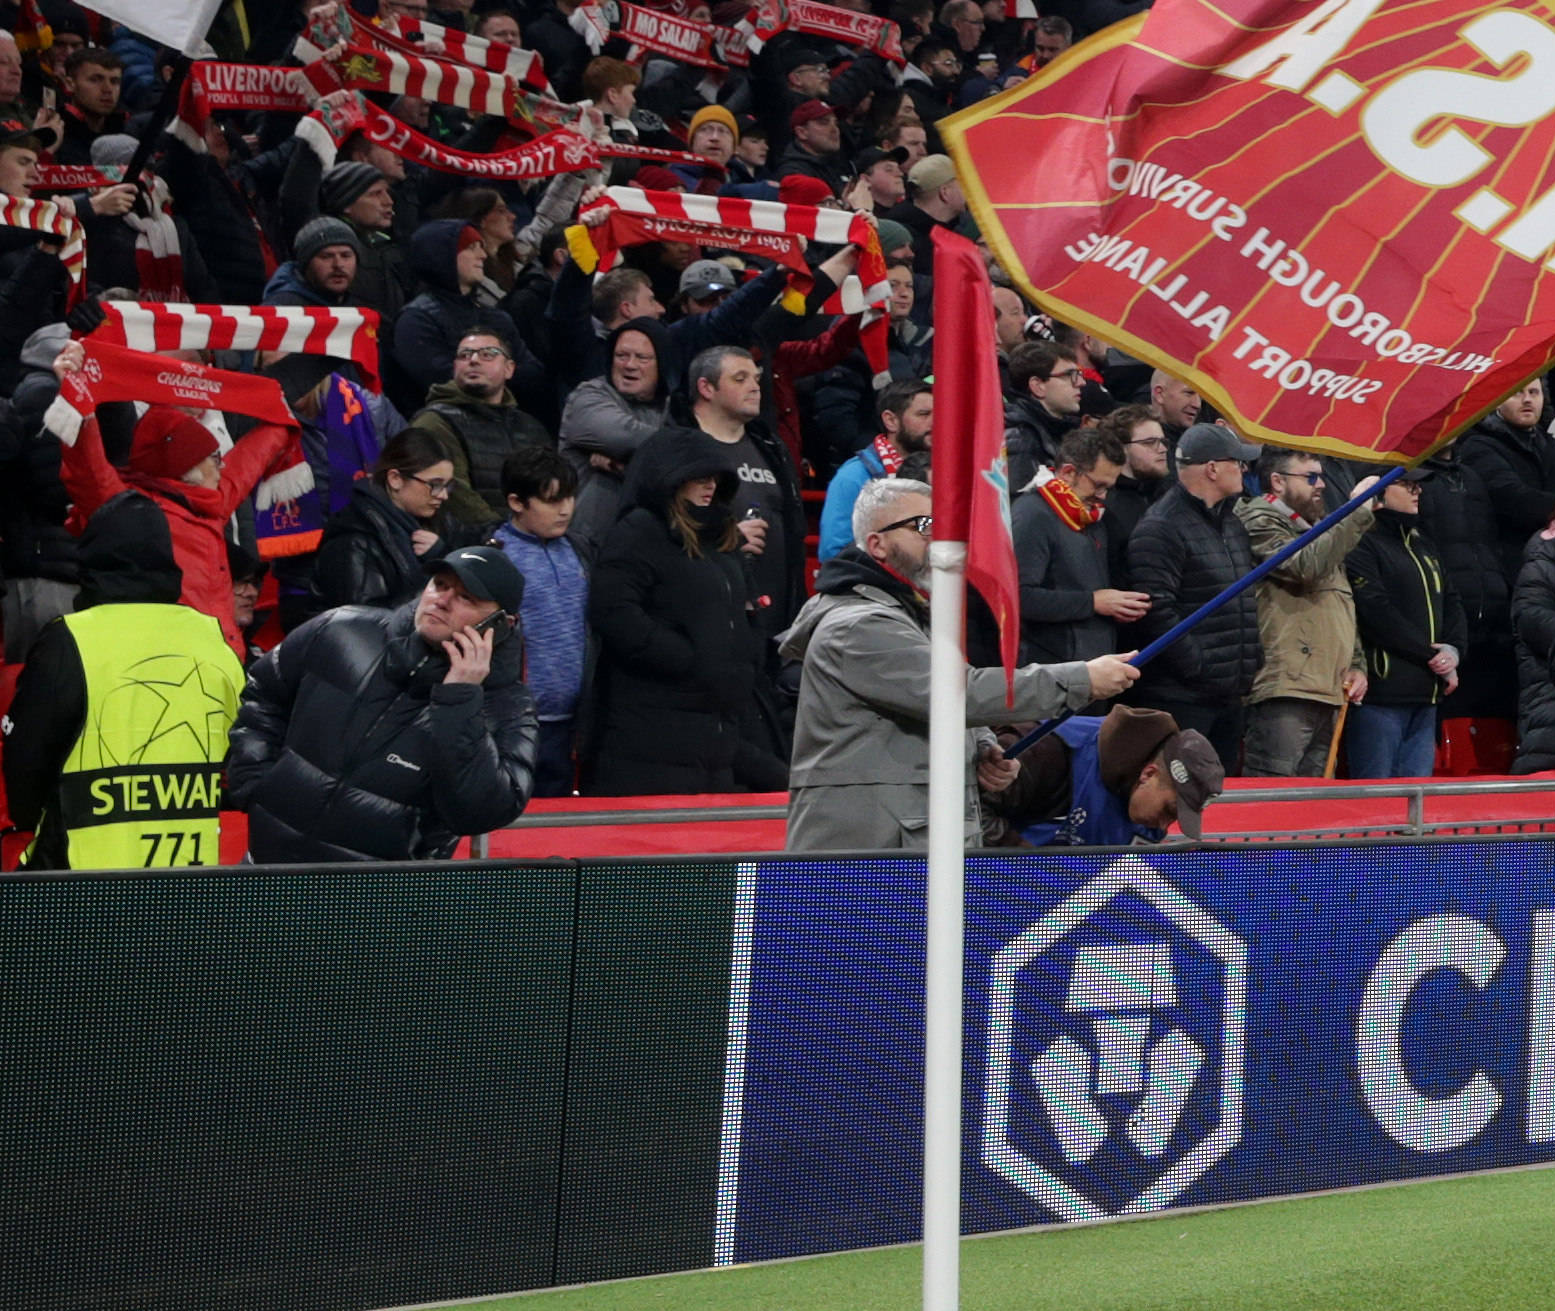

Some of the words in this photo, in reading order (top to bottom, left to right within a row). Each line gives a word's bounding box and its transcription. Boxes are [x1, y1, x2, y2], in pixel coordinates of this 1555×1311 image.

[635, 13, 658, 41] MO
[659, 19, 702, 53] SALAH
[714, 25, 746, 54] ALAH
[205, 64, 305, 95] LIVERPOO
[242, 94, 271, 105] NEVER
[51, 173, 97, 185] ALONE
[157, 371, 222, 394] CHAMPIONS
[271, 513, 301, 531] LFC
[141, 832, 203, 868] 771
